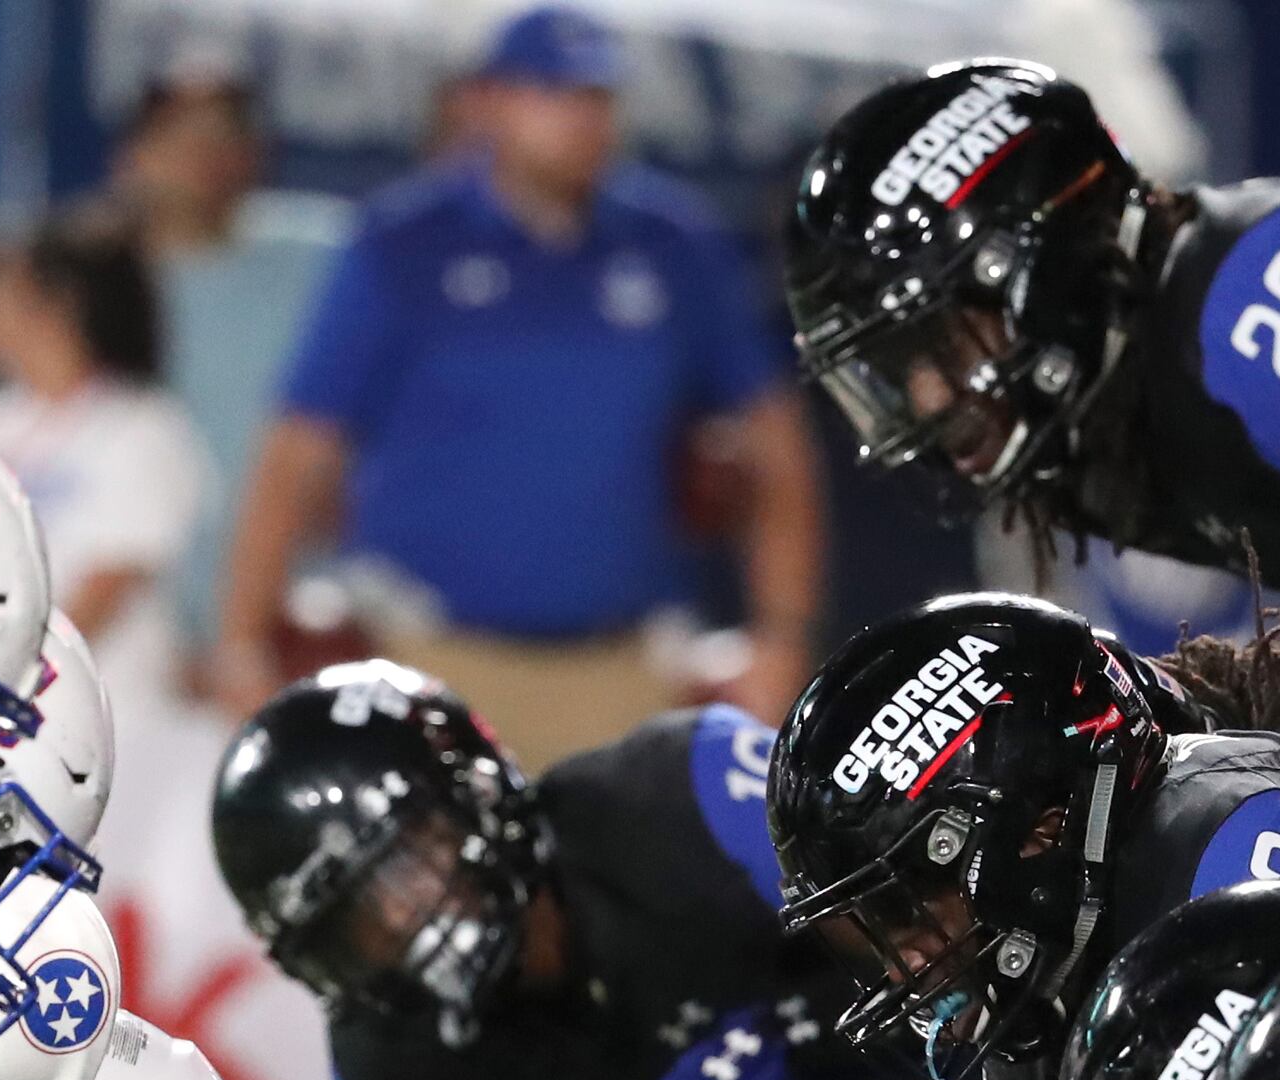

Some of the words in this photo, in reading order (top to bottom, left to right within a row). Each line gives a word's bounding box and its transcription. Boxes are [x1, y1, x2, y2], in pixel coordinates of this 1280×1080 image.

[871, 73, 1043, 206] GEORGIA
[920, 103, 1031, 203] STATE
[832, 634, 999, 795] GEORGIA
[878, 667, 1003, 793] STATE
